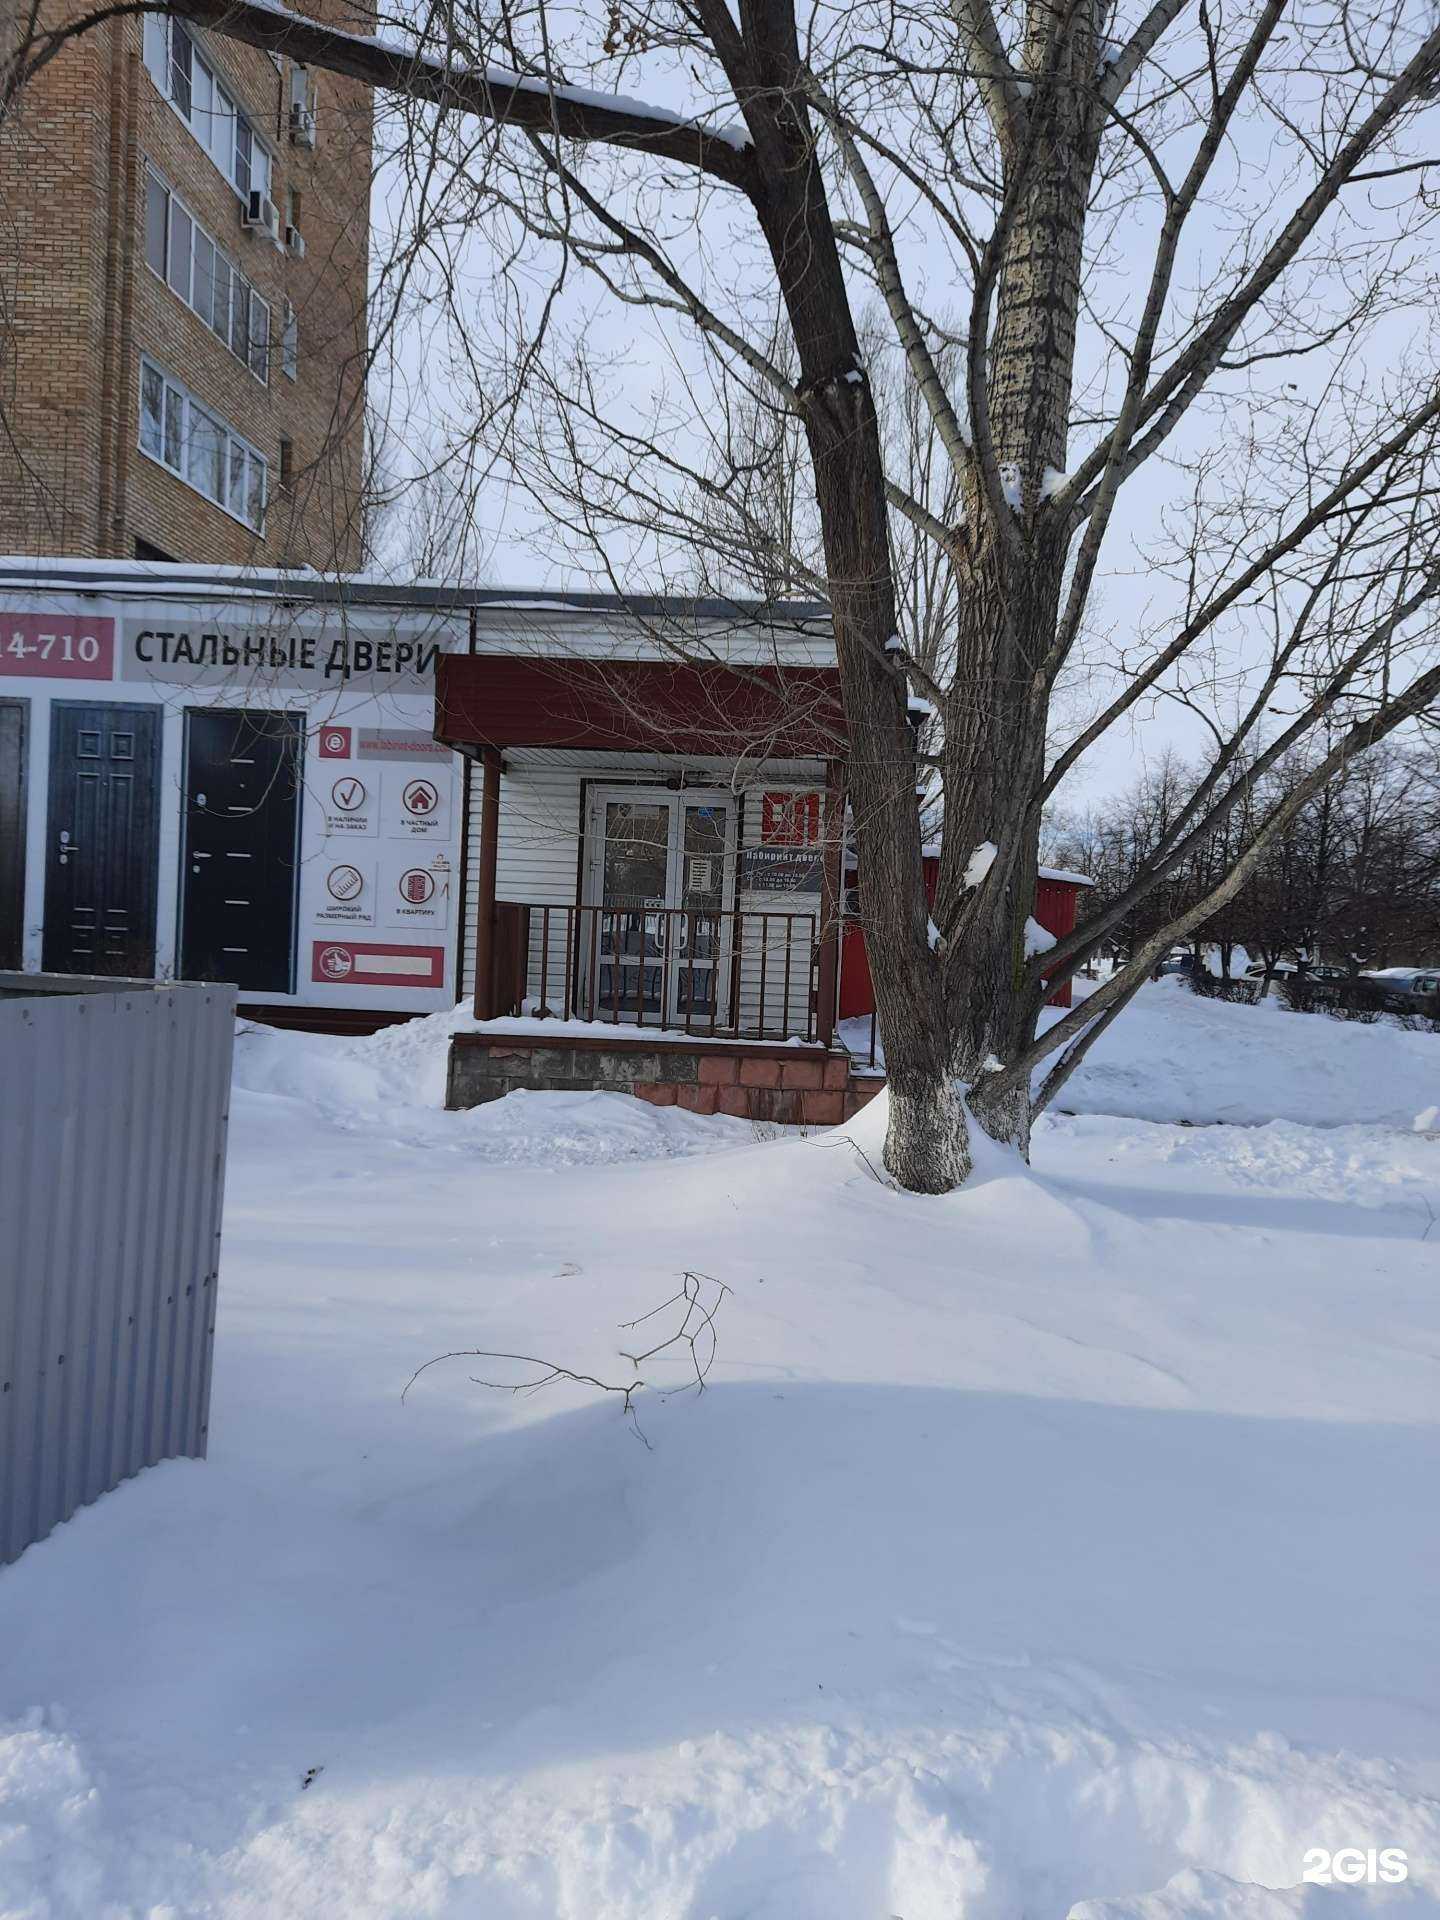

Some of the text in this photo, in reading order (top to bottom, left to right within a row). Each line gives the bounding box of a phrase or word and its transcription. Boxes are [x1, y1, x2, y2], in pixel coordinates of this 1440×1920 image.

[0, 631, 99, 662] 4-710
[135, 631, 440, 679] СТАЛЬНЫЕ ДВЕРИ
[411, 826, 428, 834] ДОМ
